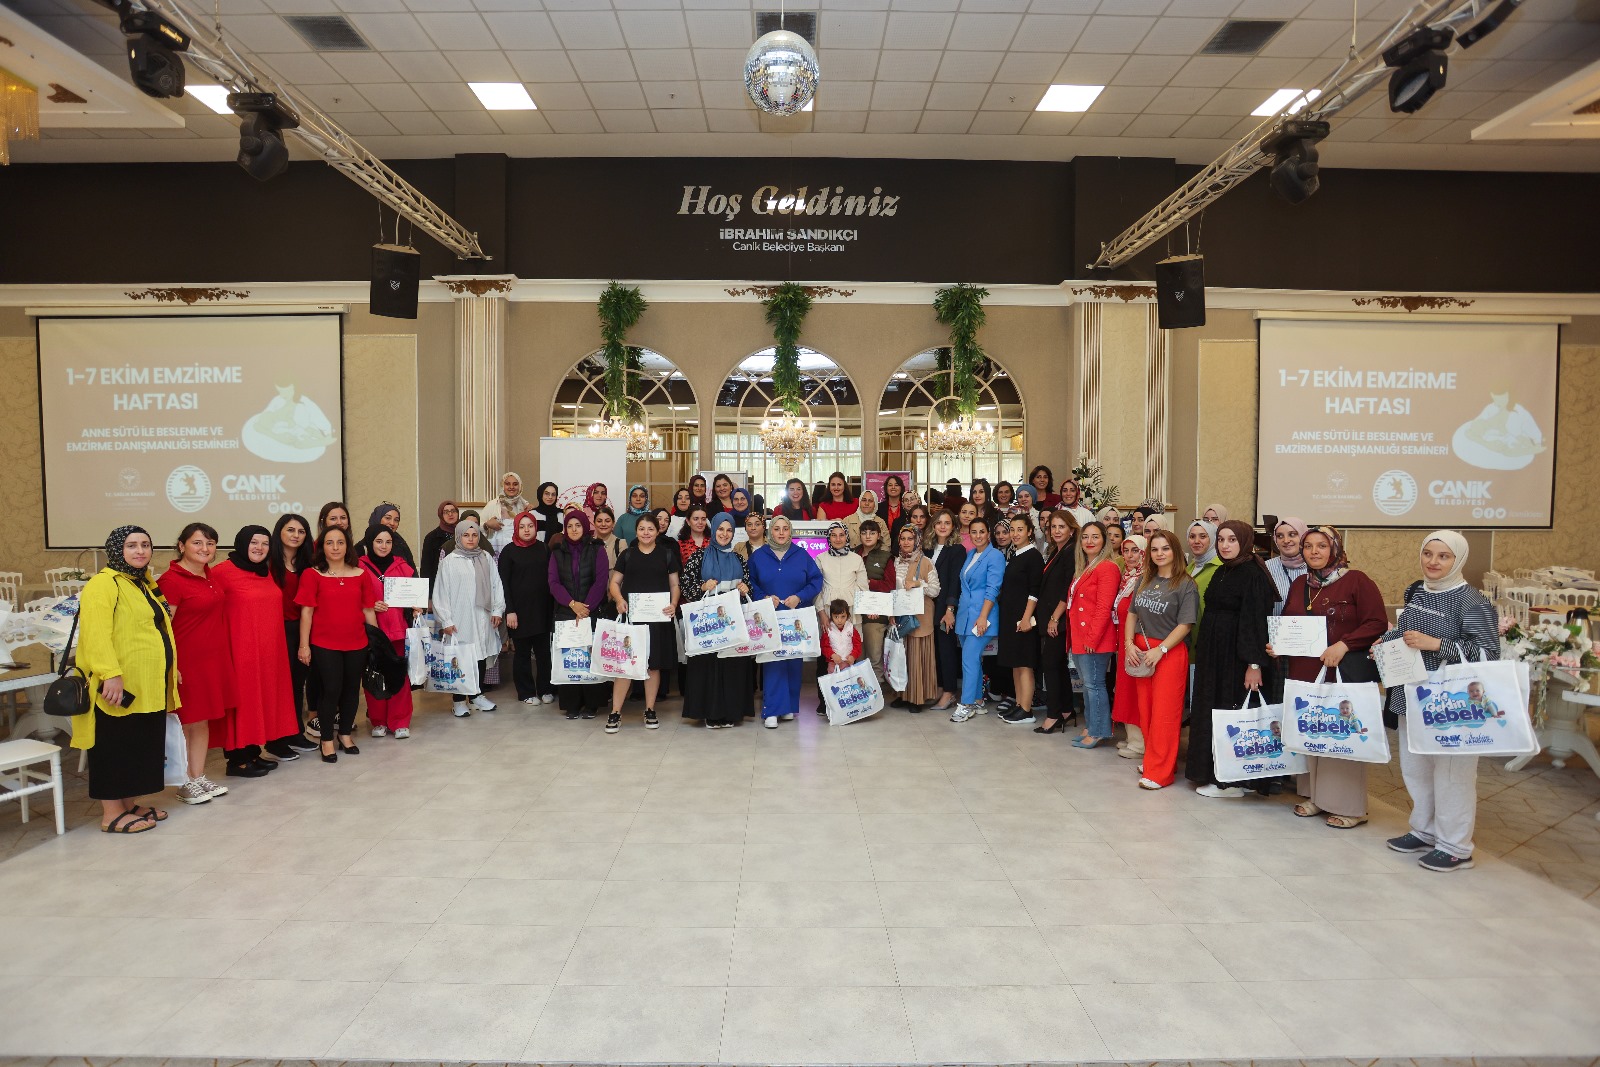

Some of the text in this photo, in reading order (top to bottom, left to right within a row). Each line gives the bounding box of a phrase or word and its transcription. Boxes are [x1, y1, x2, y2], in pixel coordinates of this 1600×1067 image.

[677, 186, 900, 221] Hoş Geldiniz
[787, 228, 858, 241] SANDIKÇI
[763, 242, 805, 252] Belediye
[808, 242, 844, 253] Başkanı
[101, 364, 149, 385] EKİM
[154, 362, 242, 384] EMZİRME
[1313, 366, 1363, 388] EKİM
[1367, 367, 1457, 390] EMZİRME
[114, 393, 198, 410] HAFTASI
[1325, 396, 1410, 415] HAFTASI
[82, 426, 223, 438] ANNE SÜTÜ İLE BESLENME VE
[1292, 430, 1434, 441] ANNE SÜTÜ İLE BESLENME VE
[66, 438, 239, 453] EMZİRME DANIŞMANLIĞI SEMİNERİ
[1275, 442, 1448, 456] EMZİRME DANIŞMANLIĞI SEMİNERİ
[1423, 704, 1486, 726] Bebek
[1298, 720, 1350, 734] Bebek
[1234, 739, 1283, 758] Bebek
